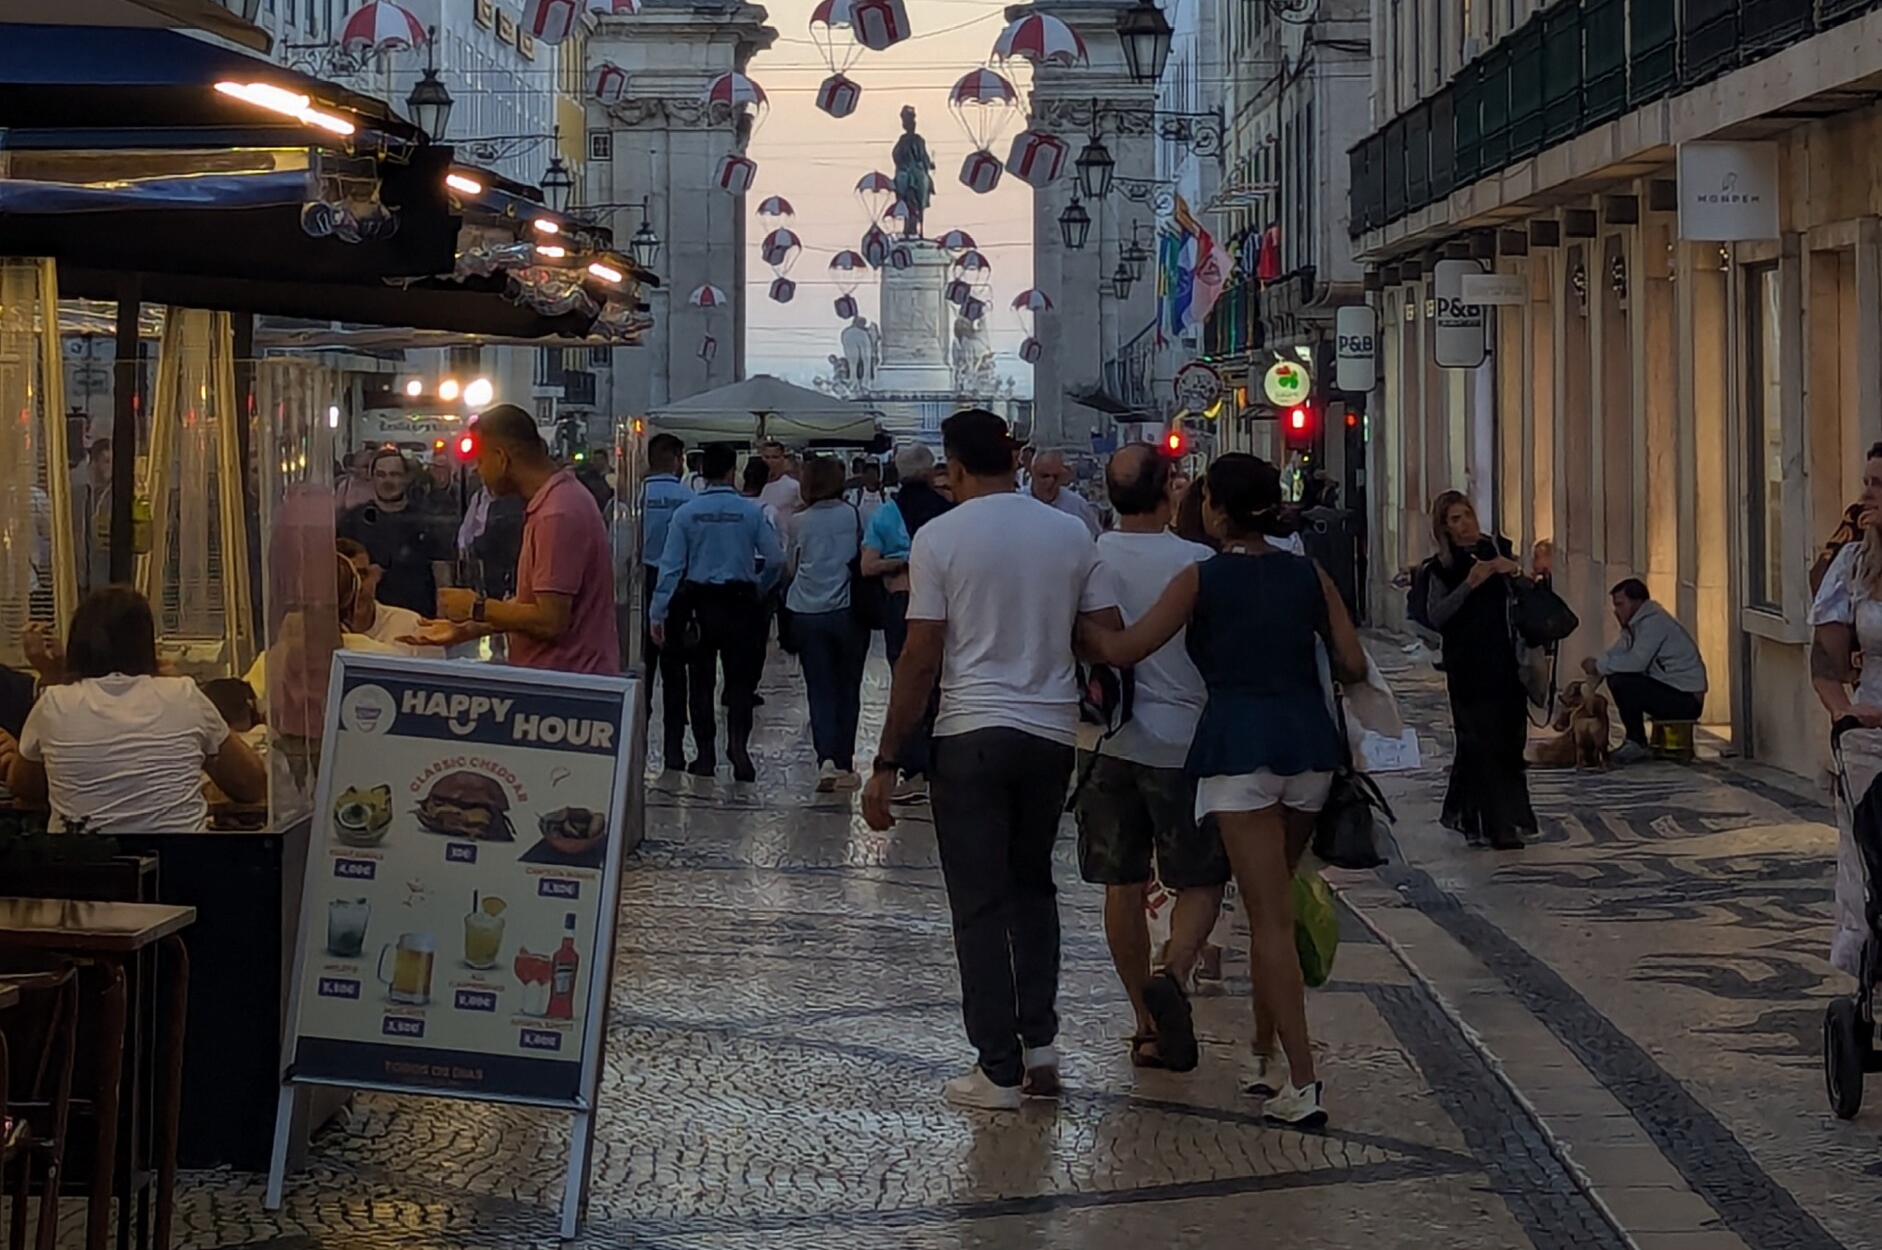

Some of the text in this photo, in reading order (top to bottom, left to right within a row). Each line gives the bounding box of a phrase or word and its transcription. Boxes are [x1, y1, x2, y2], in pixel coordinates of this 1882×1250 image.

[1338, 335, 1373, 353] P&B
[401, 690, 516, 724] HAPPY
[512, 713, 614, 749] HOUR
